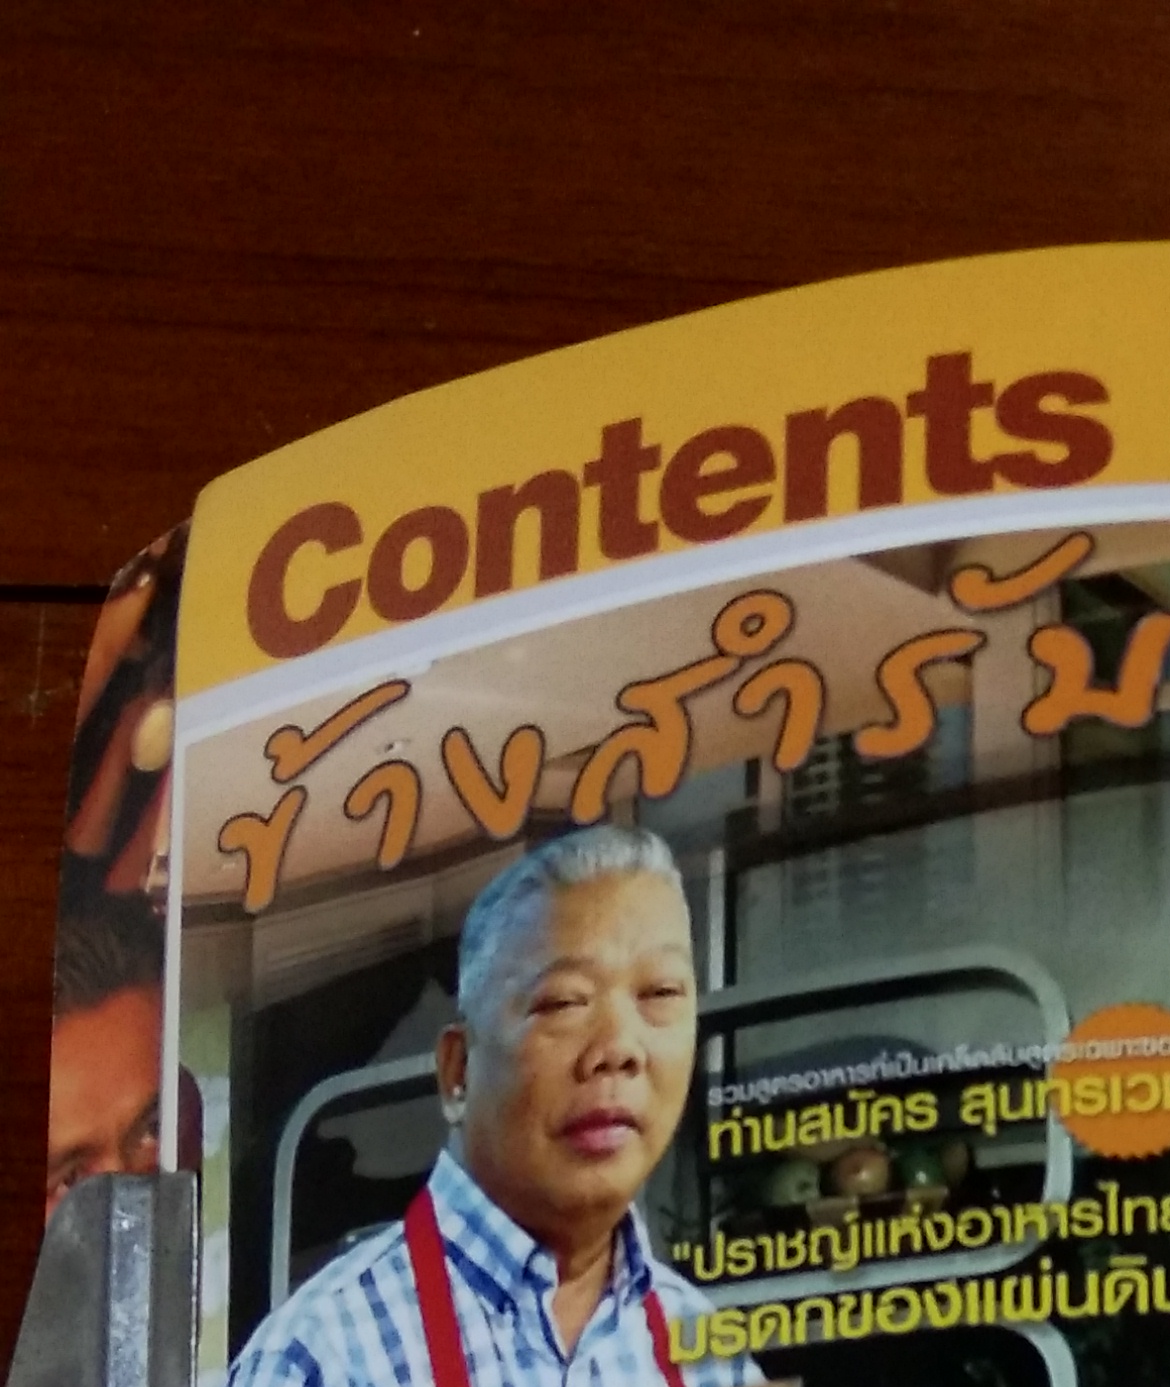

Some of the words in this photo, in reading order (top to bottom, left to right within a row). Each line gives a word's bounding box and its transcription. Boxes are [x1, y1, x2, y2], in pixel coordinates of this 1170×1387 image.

[246, 353, 1112, 660] Contents
[709, 1089, 938, 1159] ท่านสมัคร
